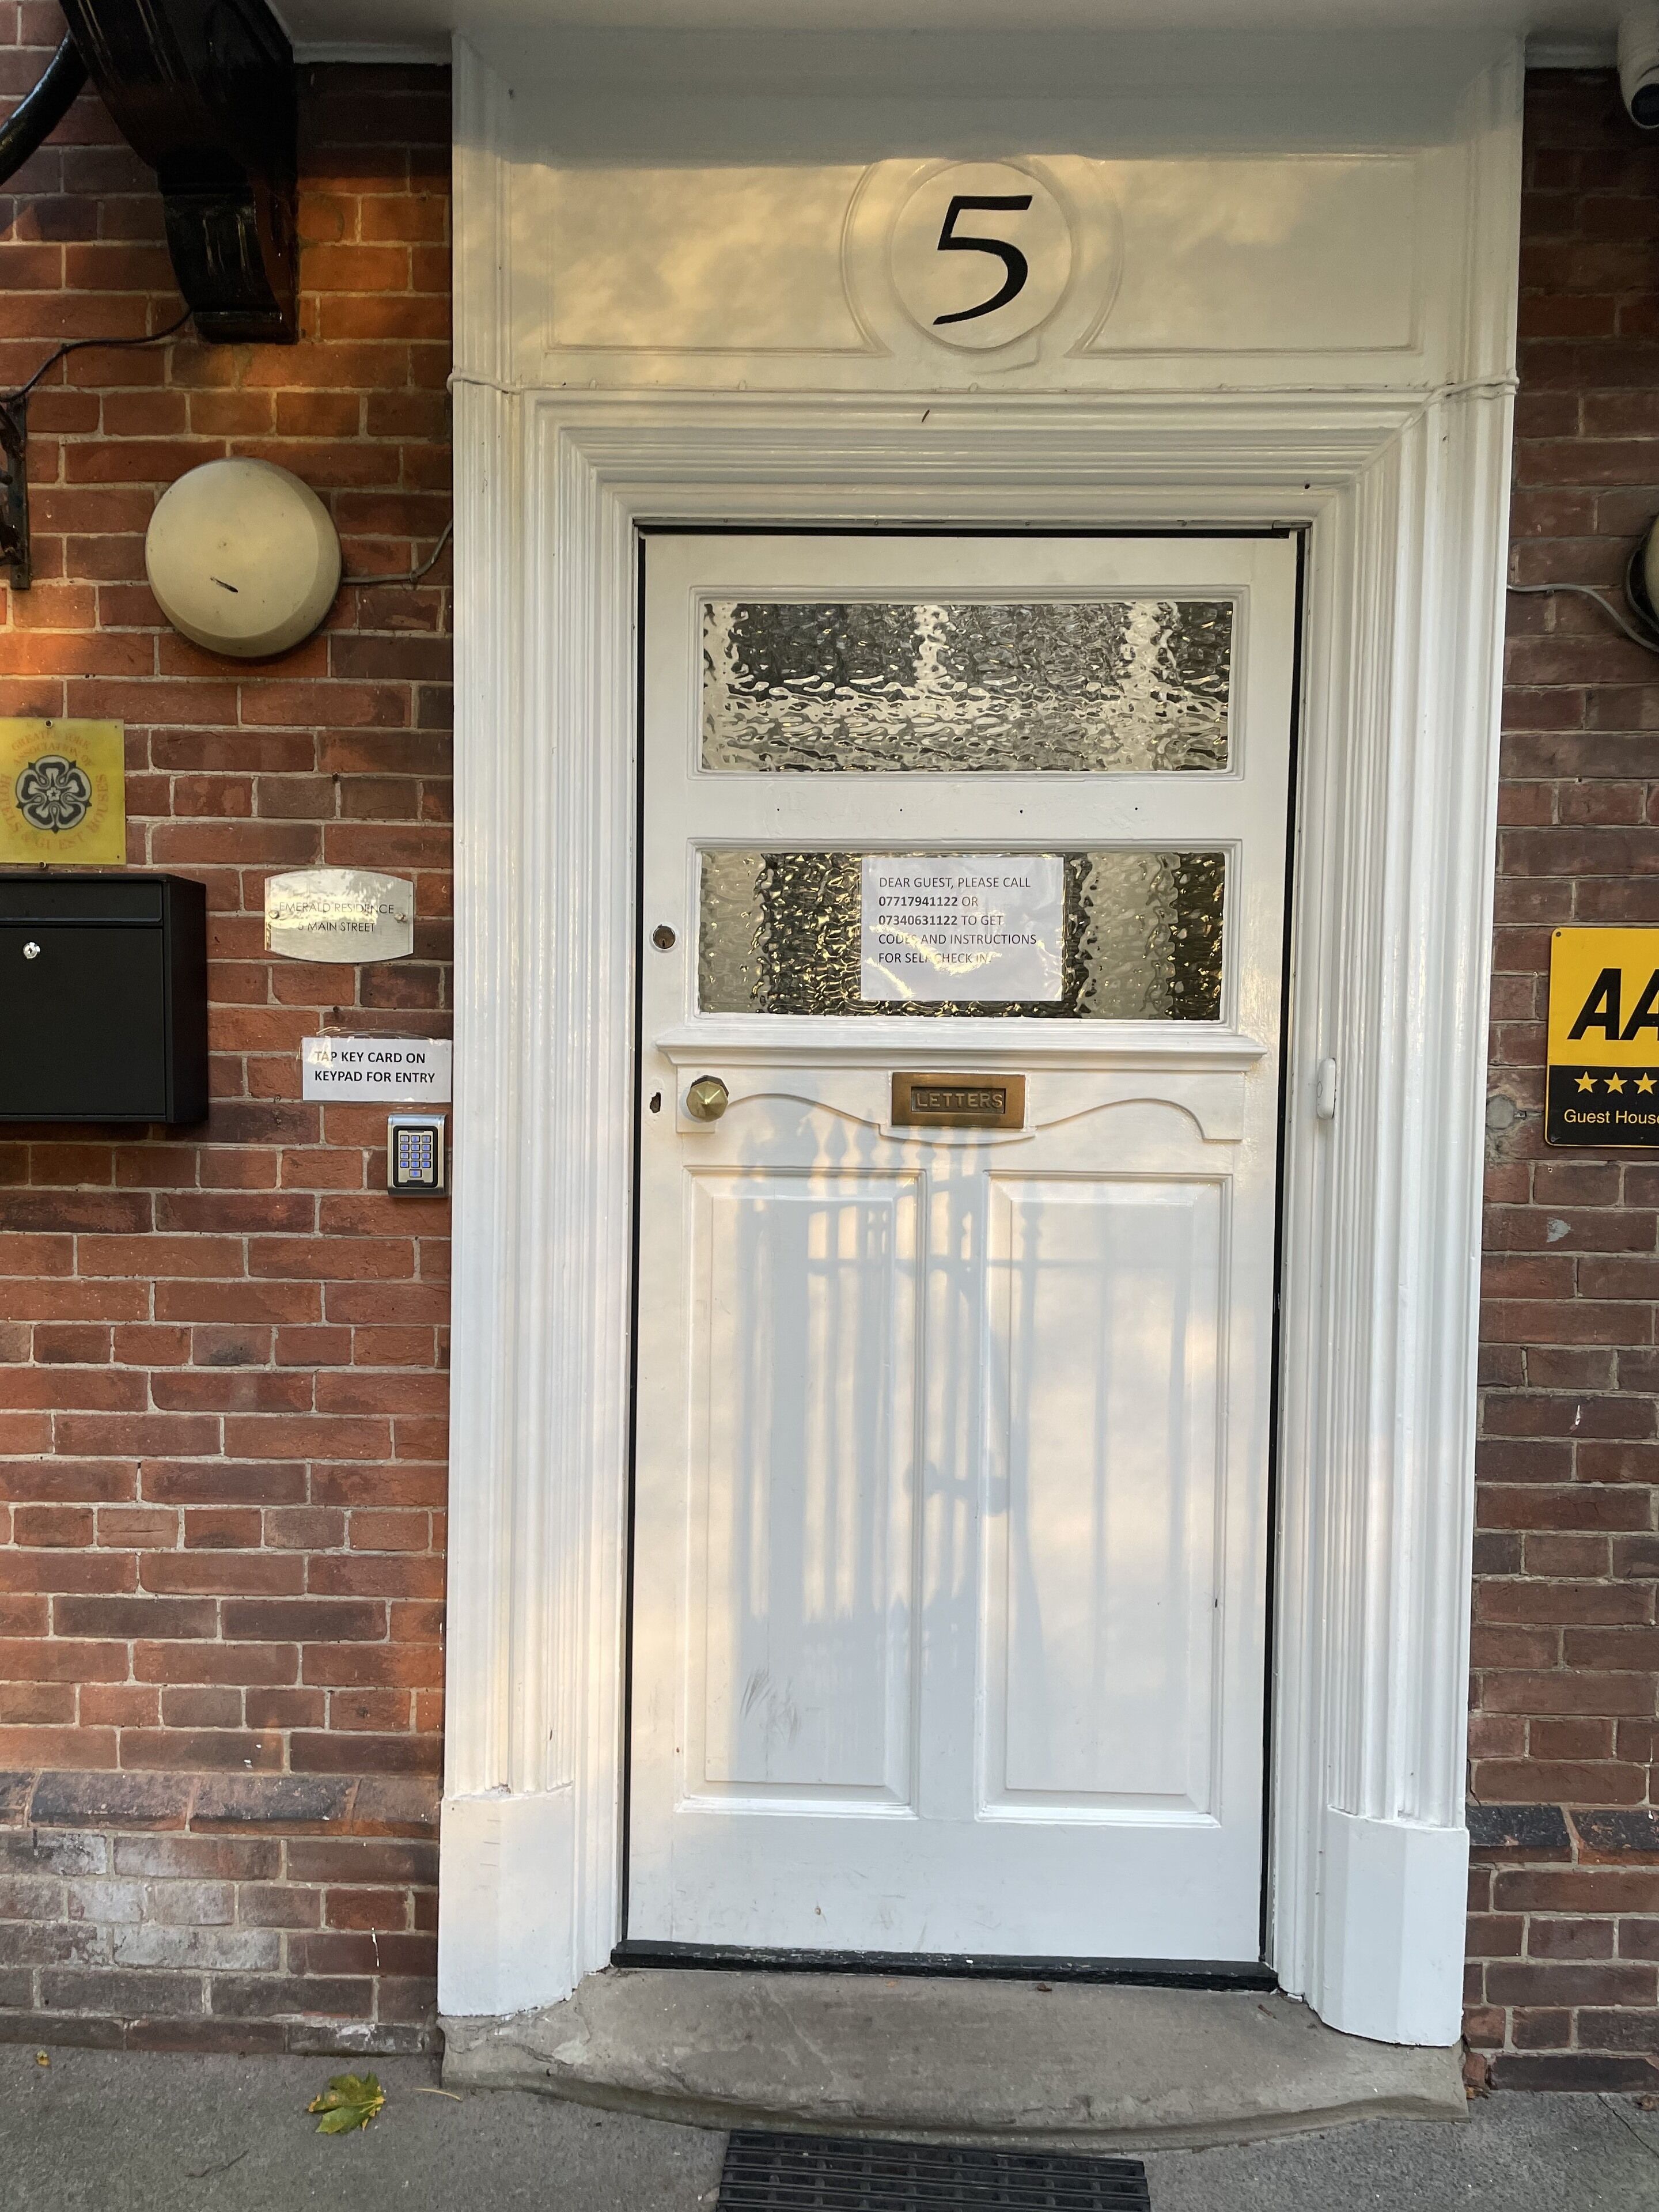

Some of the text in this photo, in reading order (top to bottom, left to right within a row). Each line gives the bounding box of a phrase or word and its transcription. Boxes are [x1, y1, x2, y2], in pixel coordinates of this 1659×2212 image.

[933, 195, 1033, 325] 5
[880, 877, 1031, 889] DEAR GUEST, PLEASE CALL
[878, 896, 978, 907] 07717941122 OR
[279, 902, 394, 914] EMERALD RESIDENCE
[308, 922, 337, 931] MAIN
[340, 923, 375, 931] STREET
[878, 915, 1003, 926] 07340631122 TO GET
[922, 934, 946, 944] AND
[950, 934, 1036, 944] INSTRUCTIONS
[879, 953, 902, 963] FOR
[934, 953, 972, 963] CHECK
[315, 1051, 425, 1063] TAP KEY CARD ON
[315, 1070, 435, 1083] KEYPAD FOR ENTRY
[916, 1093, 1003, 1108] LETTERS
[1564, 1109, 1611, 1124] Guest
